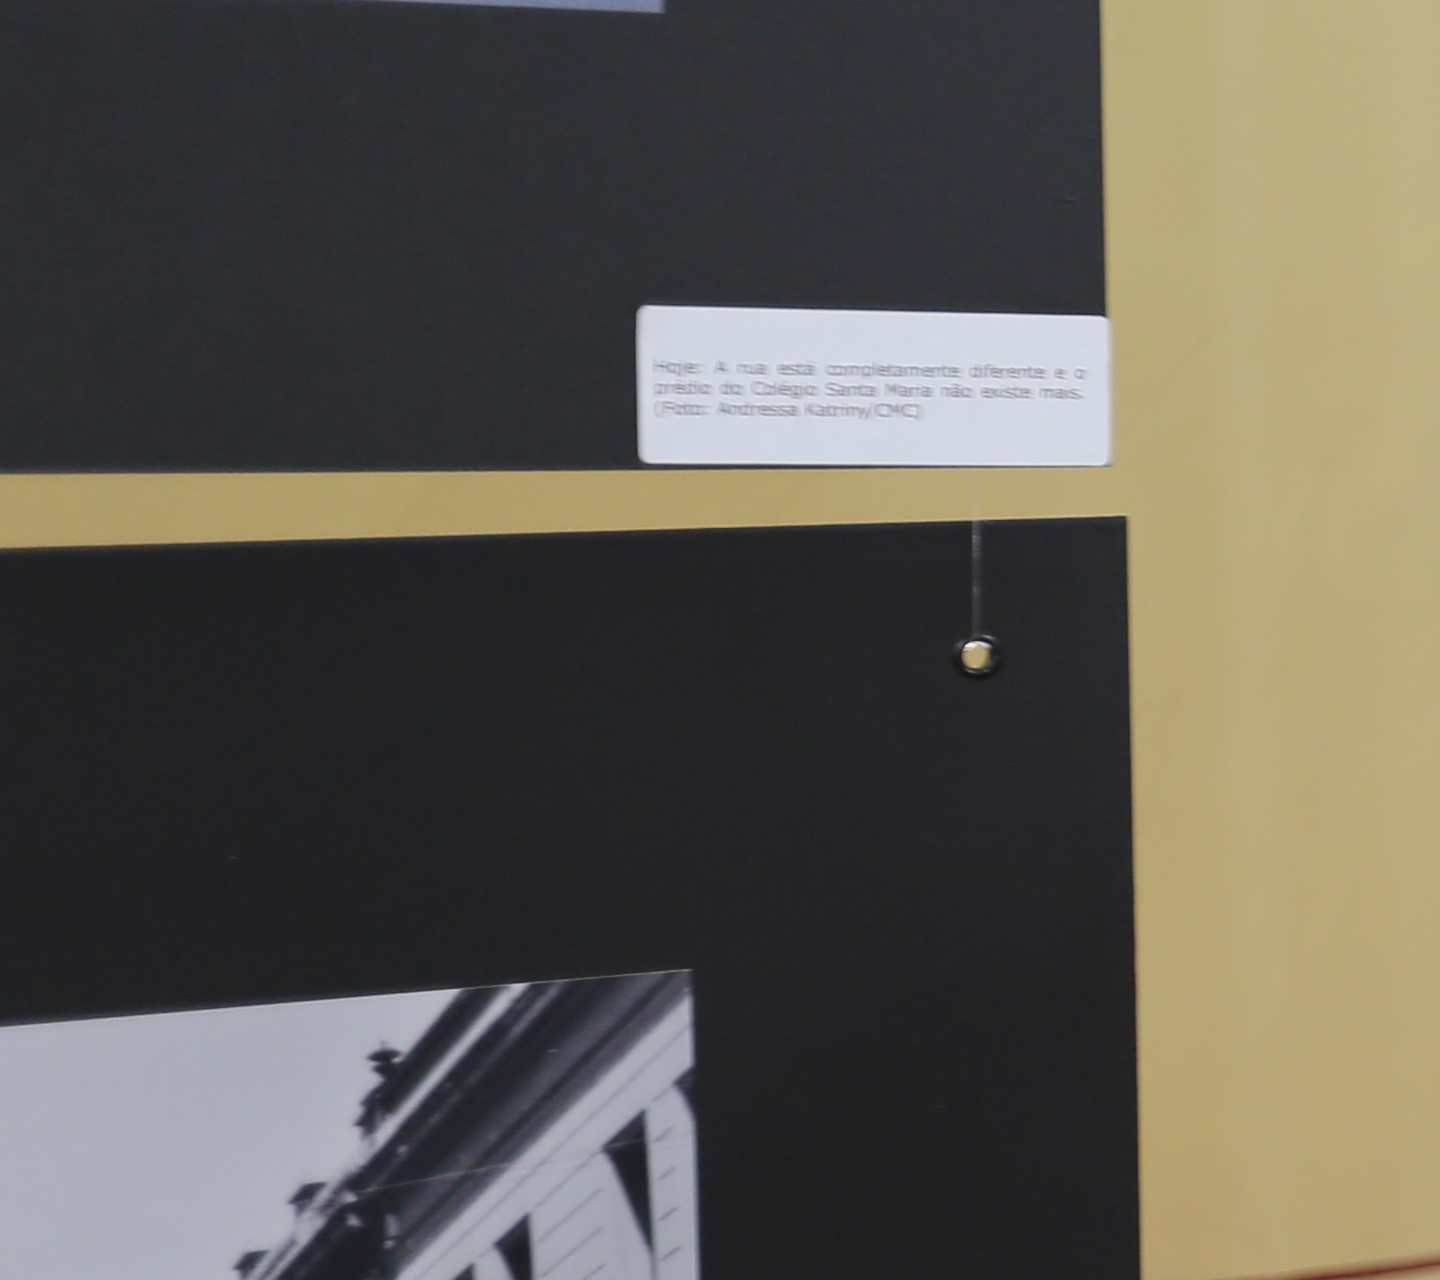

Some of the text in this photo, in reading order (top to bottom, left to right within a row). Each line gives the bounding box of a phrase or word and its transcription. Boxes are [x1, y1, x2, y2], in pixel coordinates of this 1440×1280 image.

[653, 359, 702, 378] Hoje:
[714, 360, 728, 374] A
[737, 362, 768, 375] rua
[776, 359, 815, 376] está
[825, 360, 961, 379] completamente
[968, 363, 1047, 381] diferente
[1054, 367, 1068, 380] e
[653, 380, 711, 397] prédio
[719, 382, 744, 396] do
[750, 380, 818, 399] Colégio
[824, 381, 878, 397] Santa
[884, 382, 933, 398] Maria
[940, 382, 974, 399] não
[980, 384, 1034, 400] existe
[715, 401, 799, 417] Andressa
